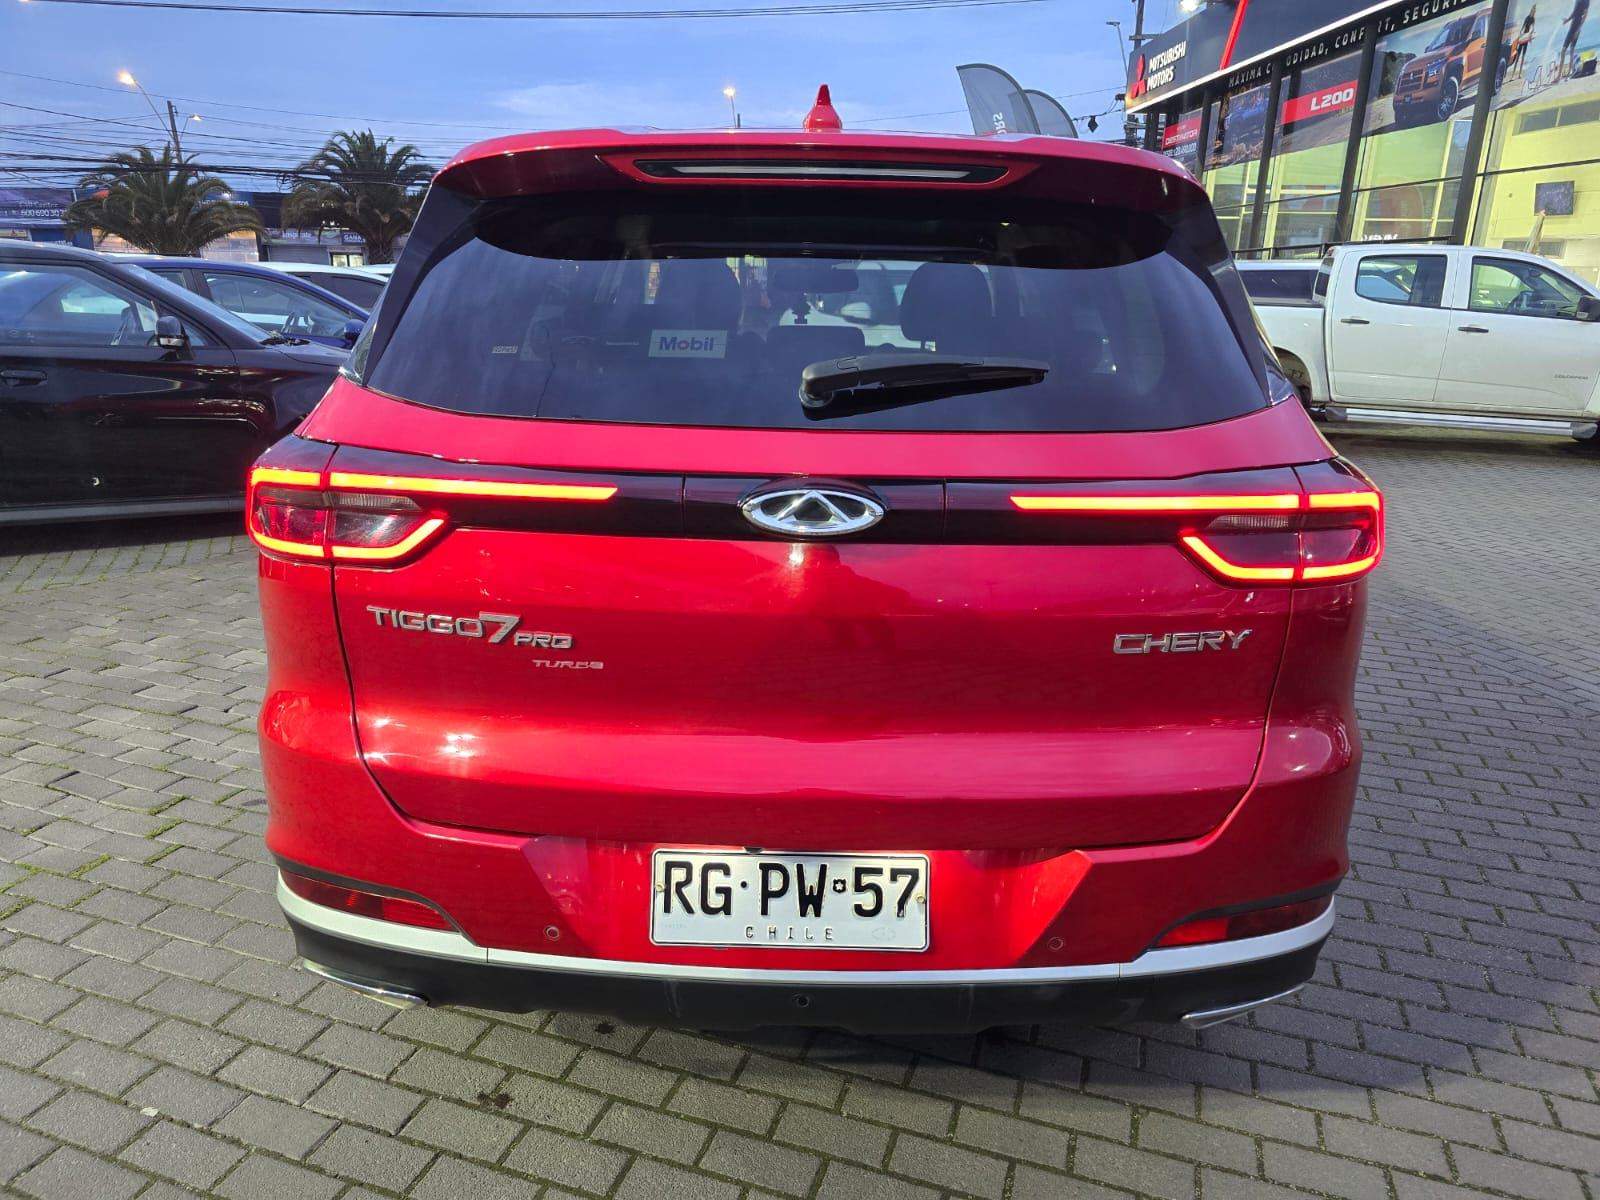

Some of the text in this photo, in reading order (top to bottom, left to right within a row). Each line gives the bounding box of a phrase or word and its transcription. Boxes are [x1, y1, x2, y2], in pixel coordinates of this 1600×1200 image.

[1148, 40, 1187, 73] MITSUBISHI
[1266, 42, 1329, 74] CODIDAD,
[1146, 65, 1175, 92] MOTORS
[1310, 87, 1355, 112] L200
[659, 336, 715, 352] Mobil
[1113, 628, 1253, 654] CHERY
[532, 658, 604, 670] TURBO
[745, 925, 833, 941] CHILE
